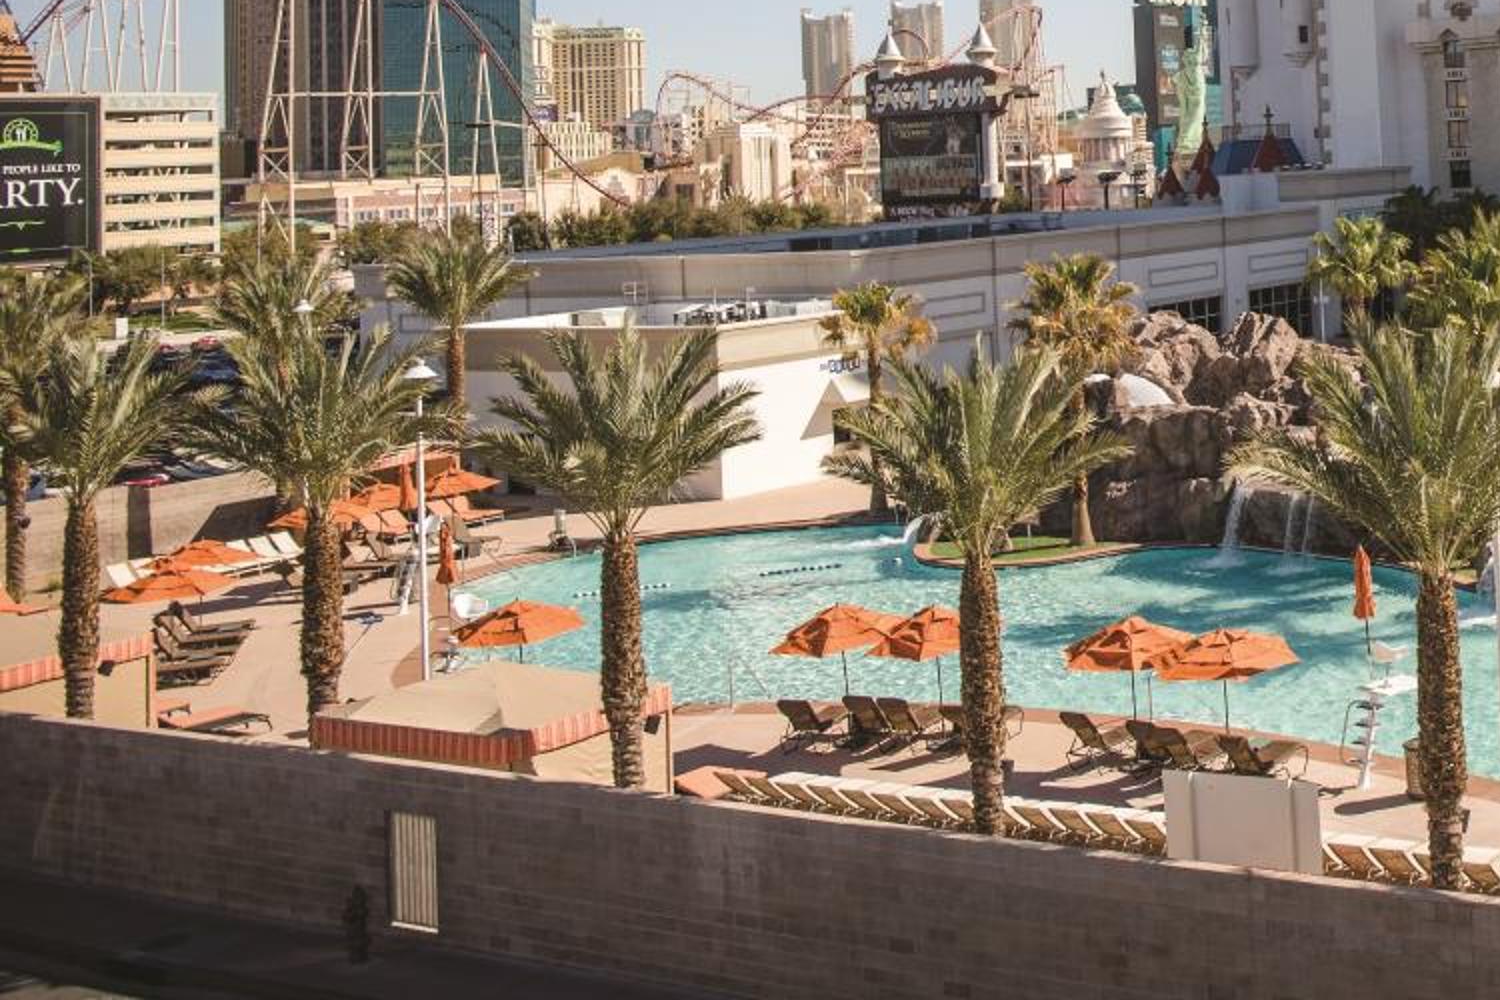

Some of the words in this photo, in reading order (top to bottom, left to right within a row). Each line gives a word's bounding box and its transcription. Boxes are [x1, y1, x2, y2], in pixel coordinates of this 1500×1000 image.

[3, 164, 37, 175] PEOPLE
[41, 164, 64, 173] LIKE
[66, 163, 81, 173] TO
[0, 178, 84, 209] RTY.
